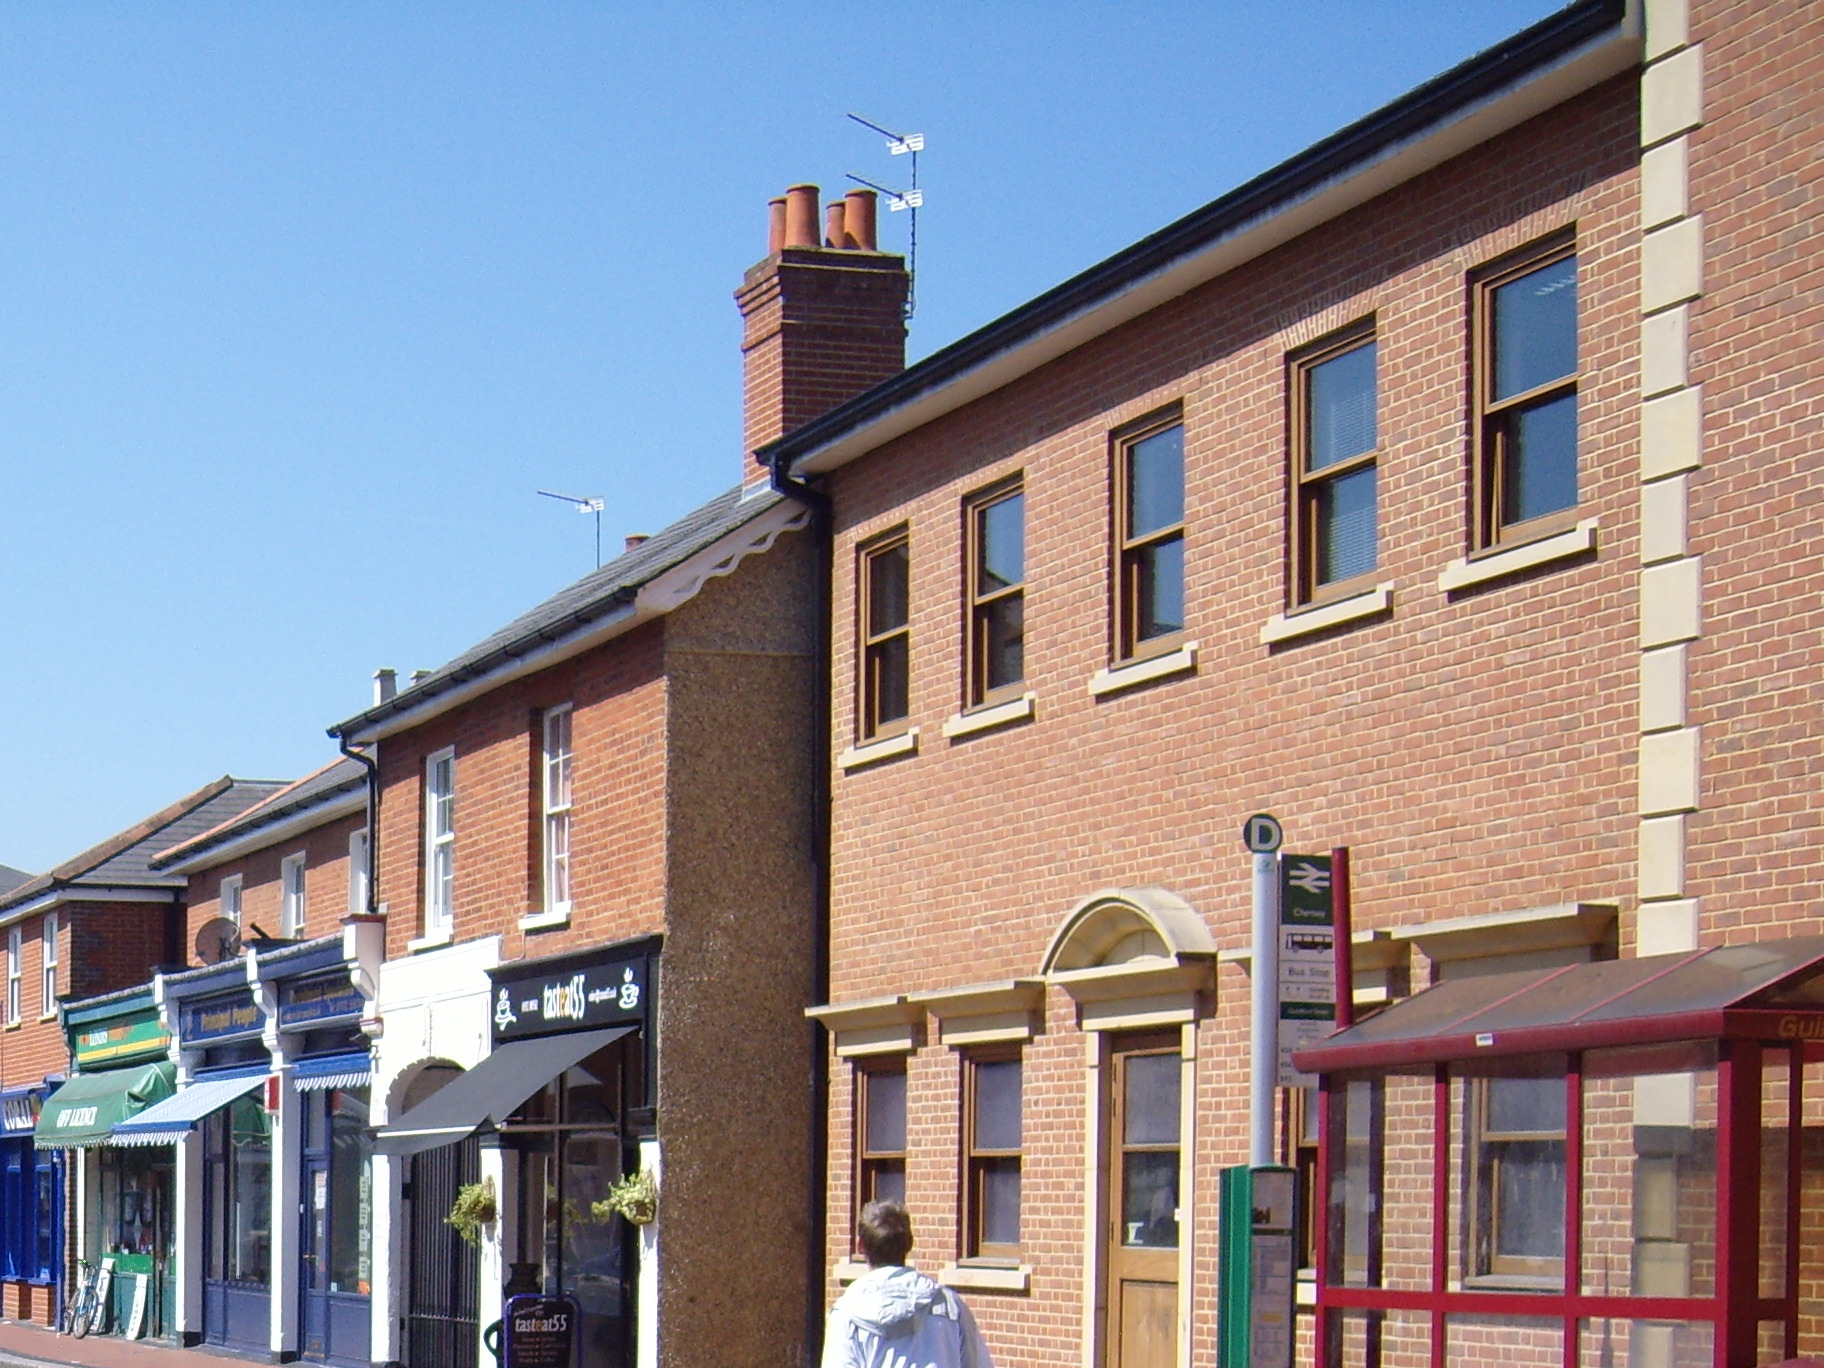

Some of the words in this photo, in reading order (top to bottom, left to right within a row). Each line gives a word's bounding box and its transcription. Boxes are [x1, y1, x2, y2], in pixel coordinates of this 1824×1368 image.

[1250, 817, 1281, 851] D
[1288, 967, 1305, 976] Bus
[1309, 967, 1330, 977] Stop
[543, 974, 585, 1020] tasteat55
[56, 1109, 73, 1128] OFF
[515, 1314, 567, 1332] tasteat55
